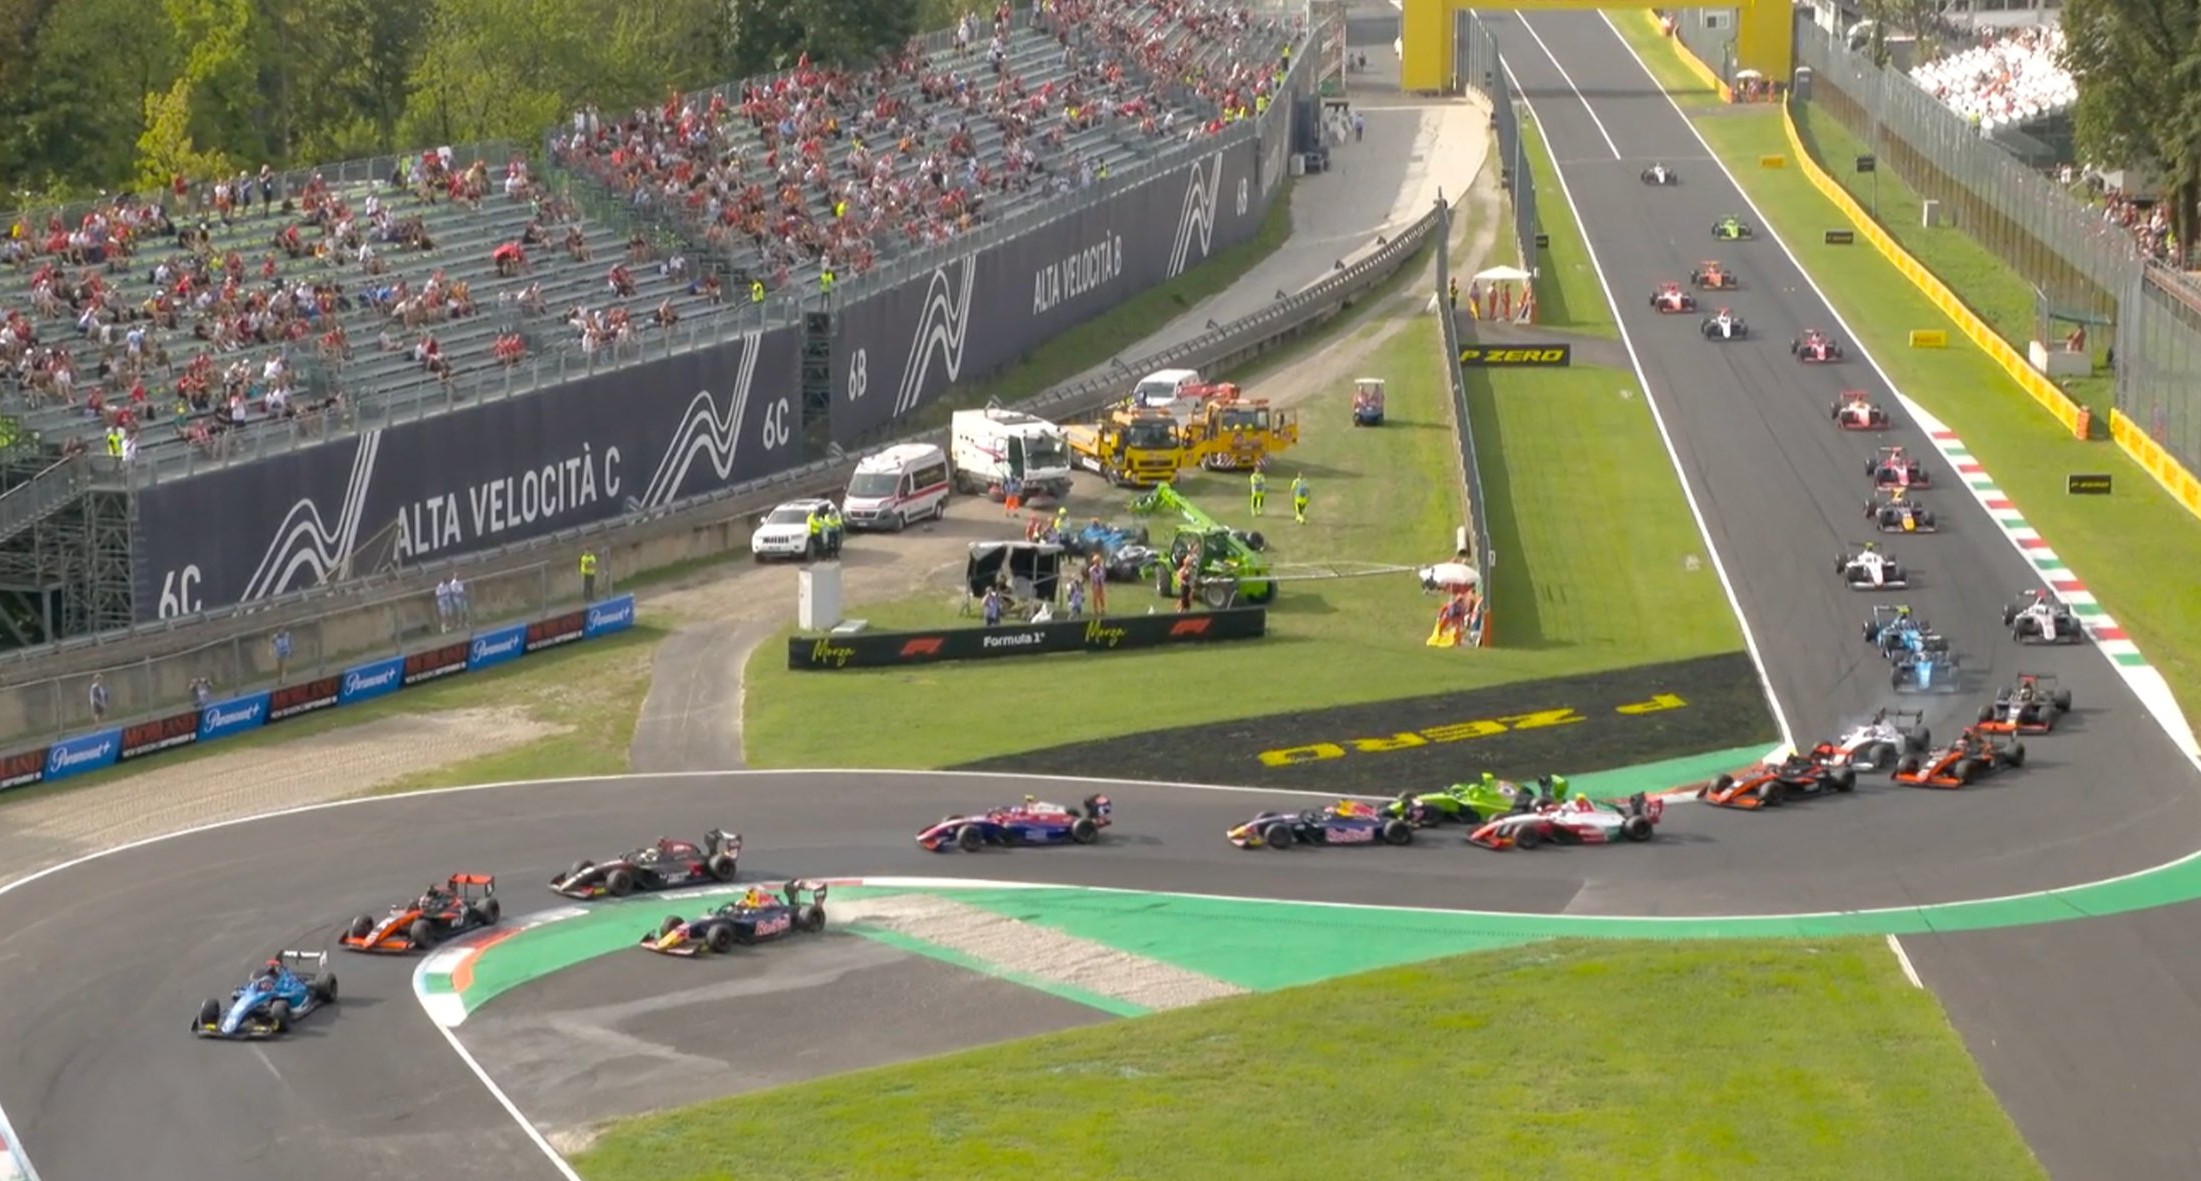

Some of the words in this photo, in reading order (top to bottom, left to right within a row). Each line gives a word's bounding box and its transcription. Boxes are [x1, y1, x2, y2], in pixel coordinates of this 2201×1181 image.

[1033, 262, 1060, 315] ALTA
[1063, 229, 1112, 300] VELOCITÀ
[848, 348, 867, 401] 6B
[1460, 350, 1480, 362] P
[1484, 350, 1564, 362] ZERO
[763, 397, 789, 450] 6C
[392, 492, 461, 561] ALTA
[469, 442, 597, 537] VELOCITÀ
[605, 446, 620, 498] C
[159, 565, 202, 619] 6C
[983, 633, 1032, 648] Formula
